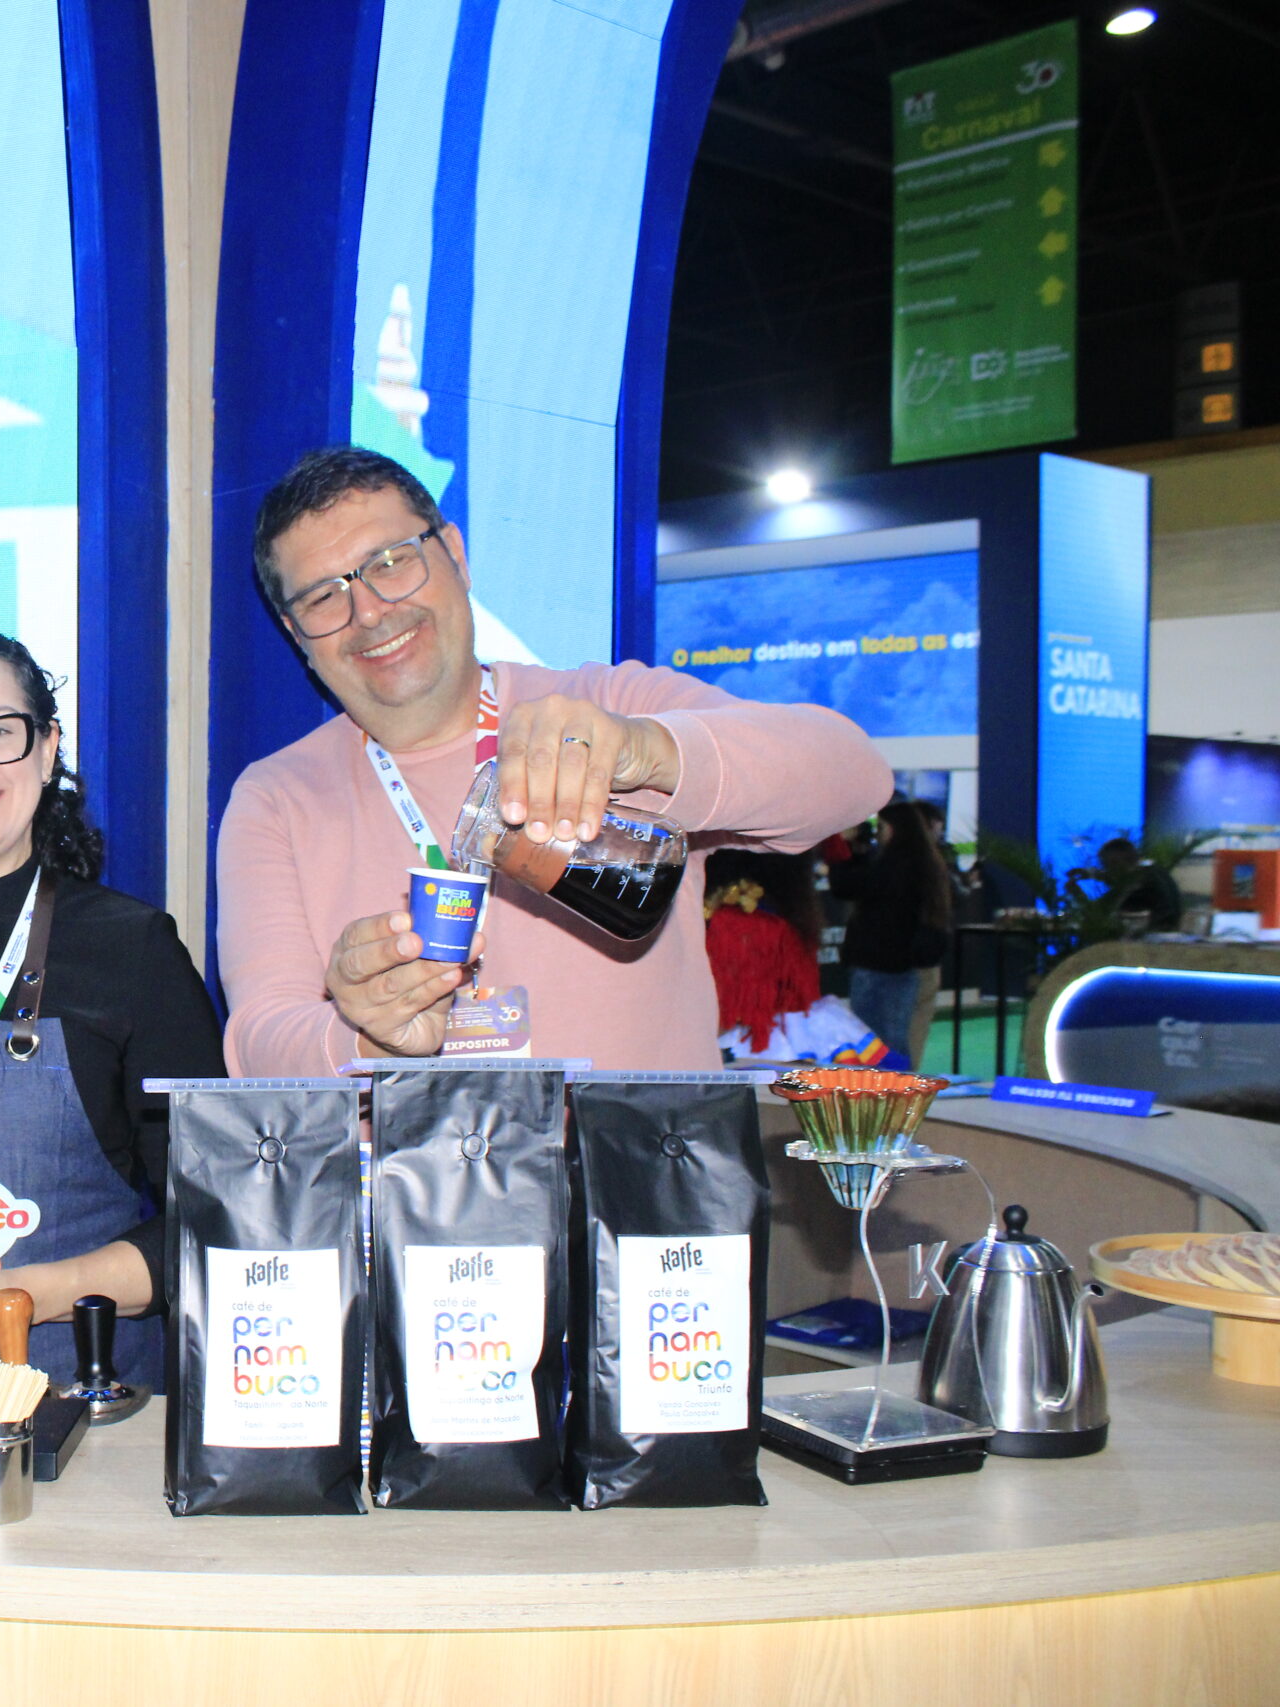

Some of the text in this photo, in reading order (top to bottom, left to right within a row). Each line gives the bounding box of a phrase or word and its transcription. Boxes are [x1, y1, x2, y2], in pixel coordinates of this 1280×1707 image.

[672, 649, 688, 667] O
[690, 646, 752, 666] melhor
[754, 640, 822, 662] destino
[825, 640, 857, 657] em
[861, 633, 918, 654] todas
[923, 634, 947, 650] as
[1049, 648, 1113, 681] SANTA
[1049, 684, 1142, 719] CATARINA
[438, 895, 472, 908] NAM
[439, 887, 470, 899] PER
[436, 904, 476, 917] BUCO
[499, 1006, 521, 1021] 30
[443, 1038, 510, 1051] EXPOSITOR
[448, 1252, 493, 1283] Kaffe
[660, 1242, 703, 1273] Kaffe
[245, 1256, 288, 1287] Kaffe
[909, 1241, 951, 1299] K
[462, 1297, 477, 1307] de
[675, 1288, 690, 1297] de
[257, 1301, 272, 1311] de
[649, 1302, 709, 1331] per
[233, 1316, 293, 1343] per
[434, 1312, 497, 1340] per
[435, 1341, 511, 1361] nam
[649, 1331, 721, 1352] nam
[234, 1345, 307, 1366] nam
[649, 1353, 732, 1382] buco
[234, 1366, 320, 1396] buco
[698, 1384, 732, 1394] Triunfo
[305, 1400, 328, 1409] Norte
